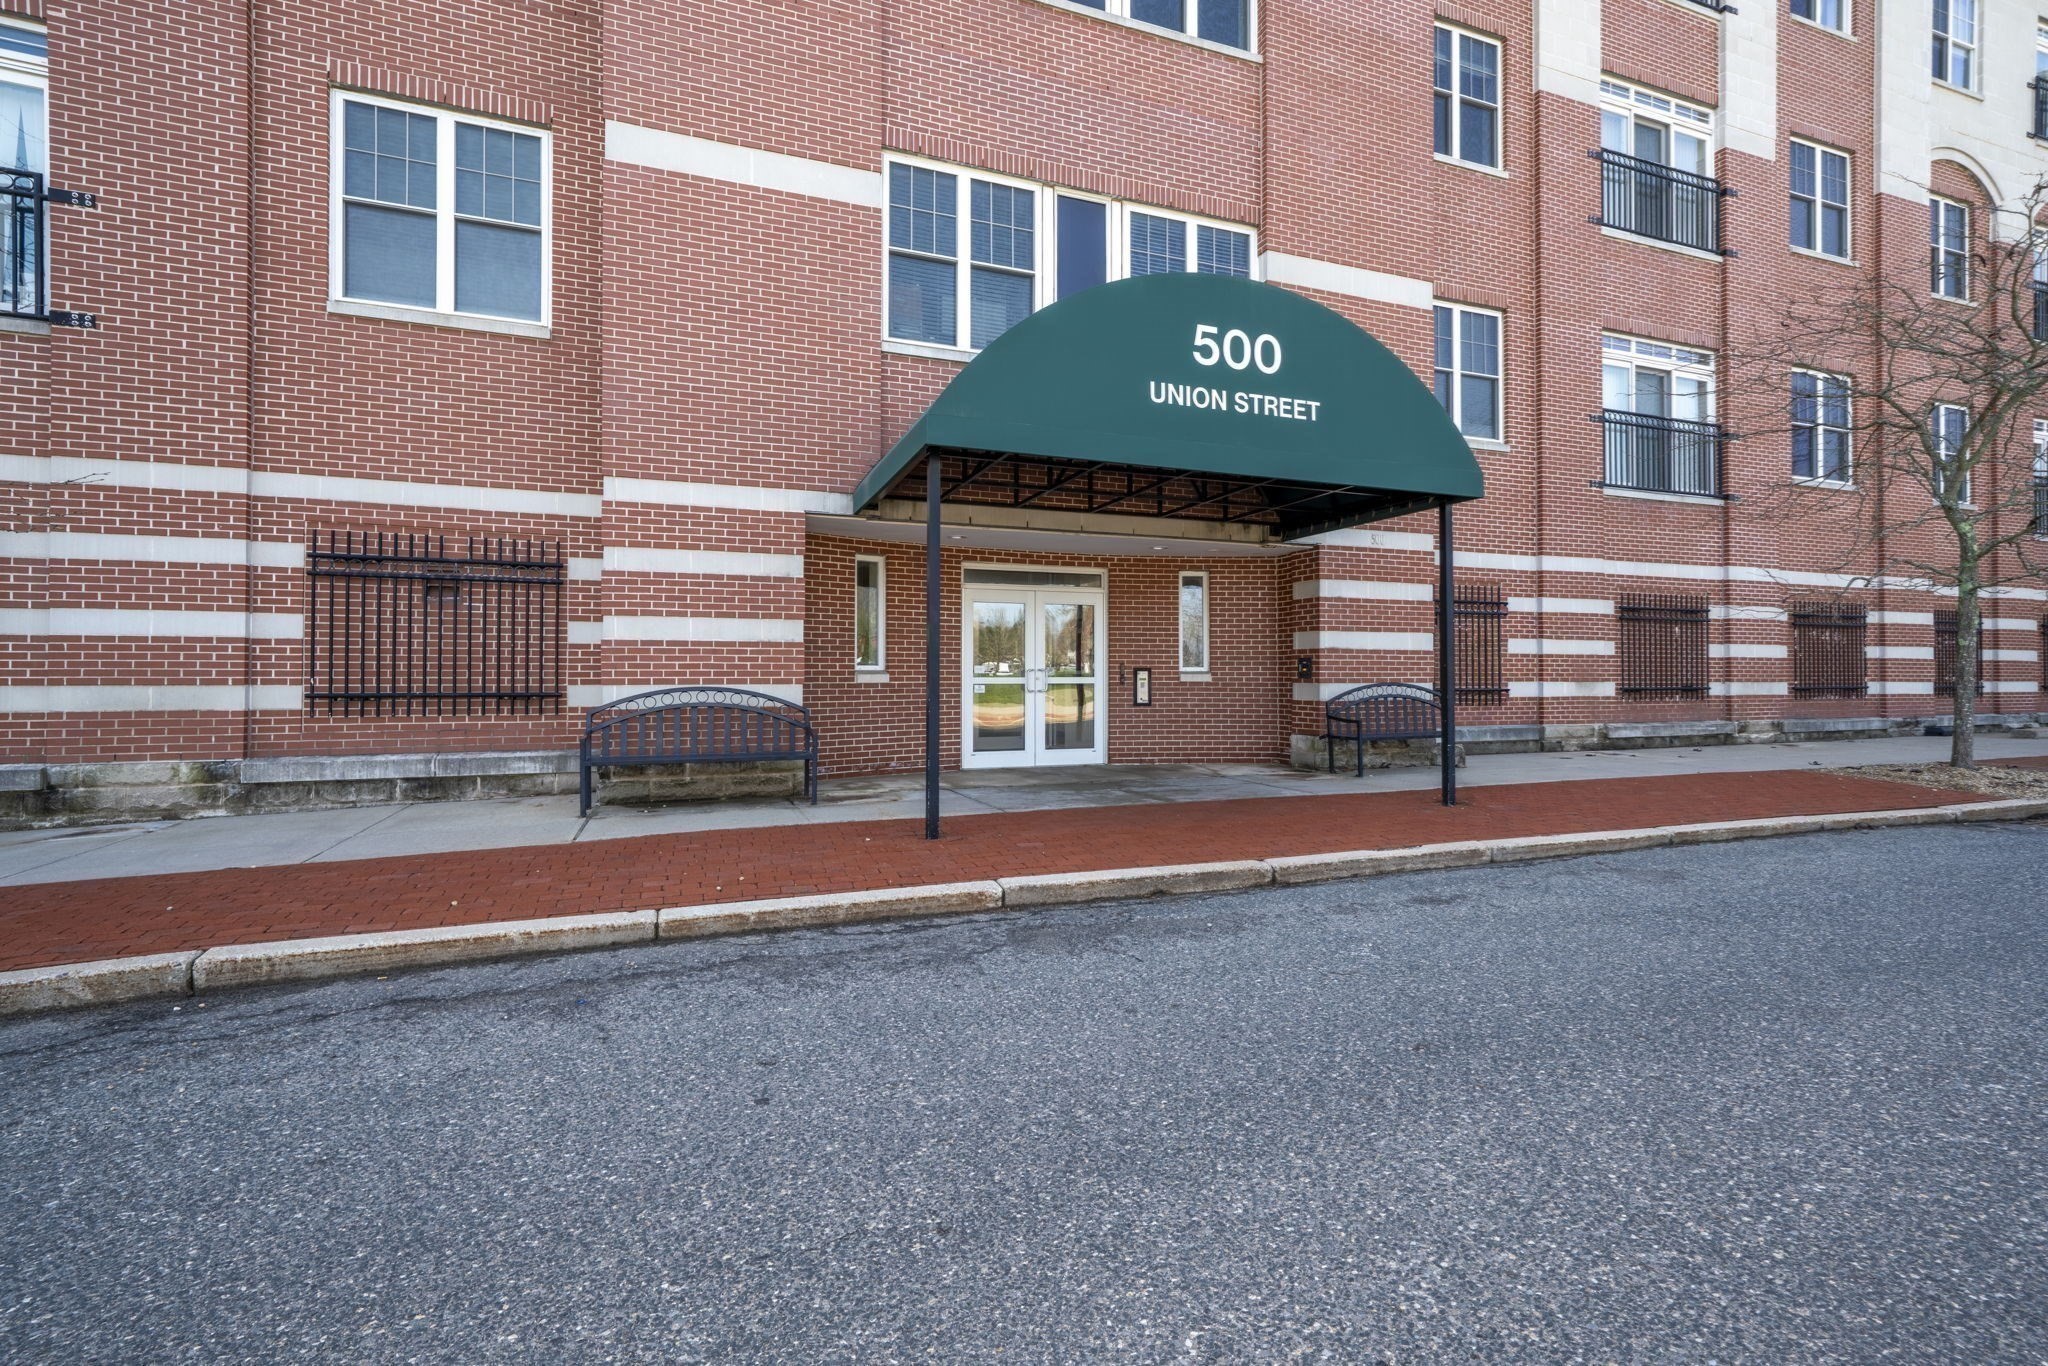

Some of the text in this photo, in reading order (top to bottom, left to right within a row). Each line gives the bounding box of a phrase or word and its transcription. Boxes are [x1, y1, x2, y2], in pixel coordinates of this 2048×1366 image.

[1192, 323, 1282, 375] 500
[1149, 380, 1321, 422] UNION STREET
